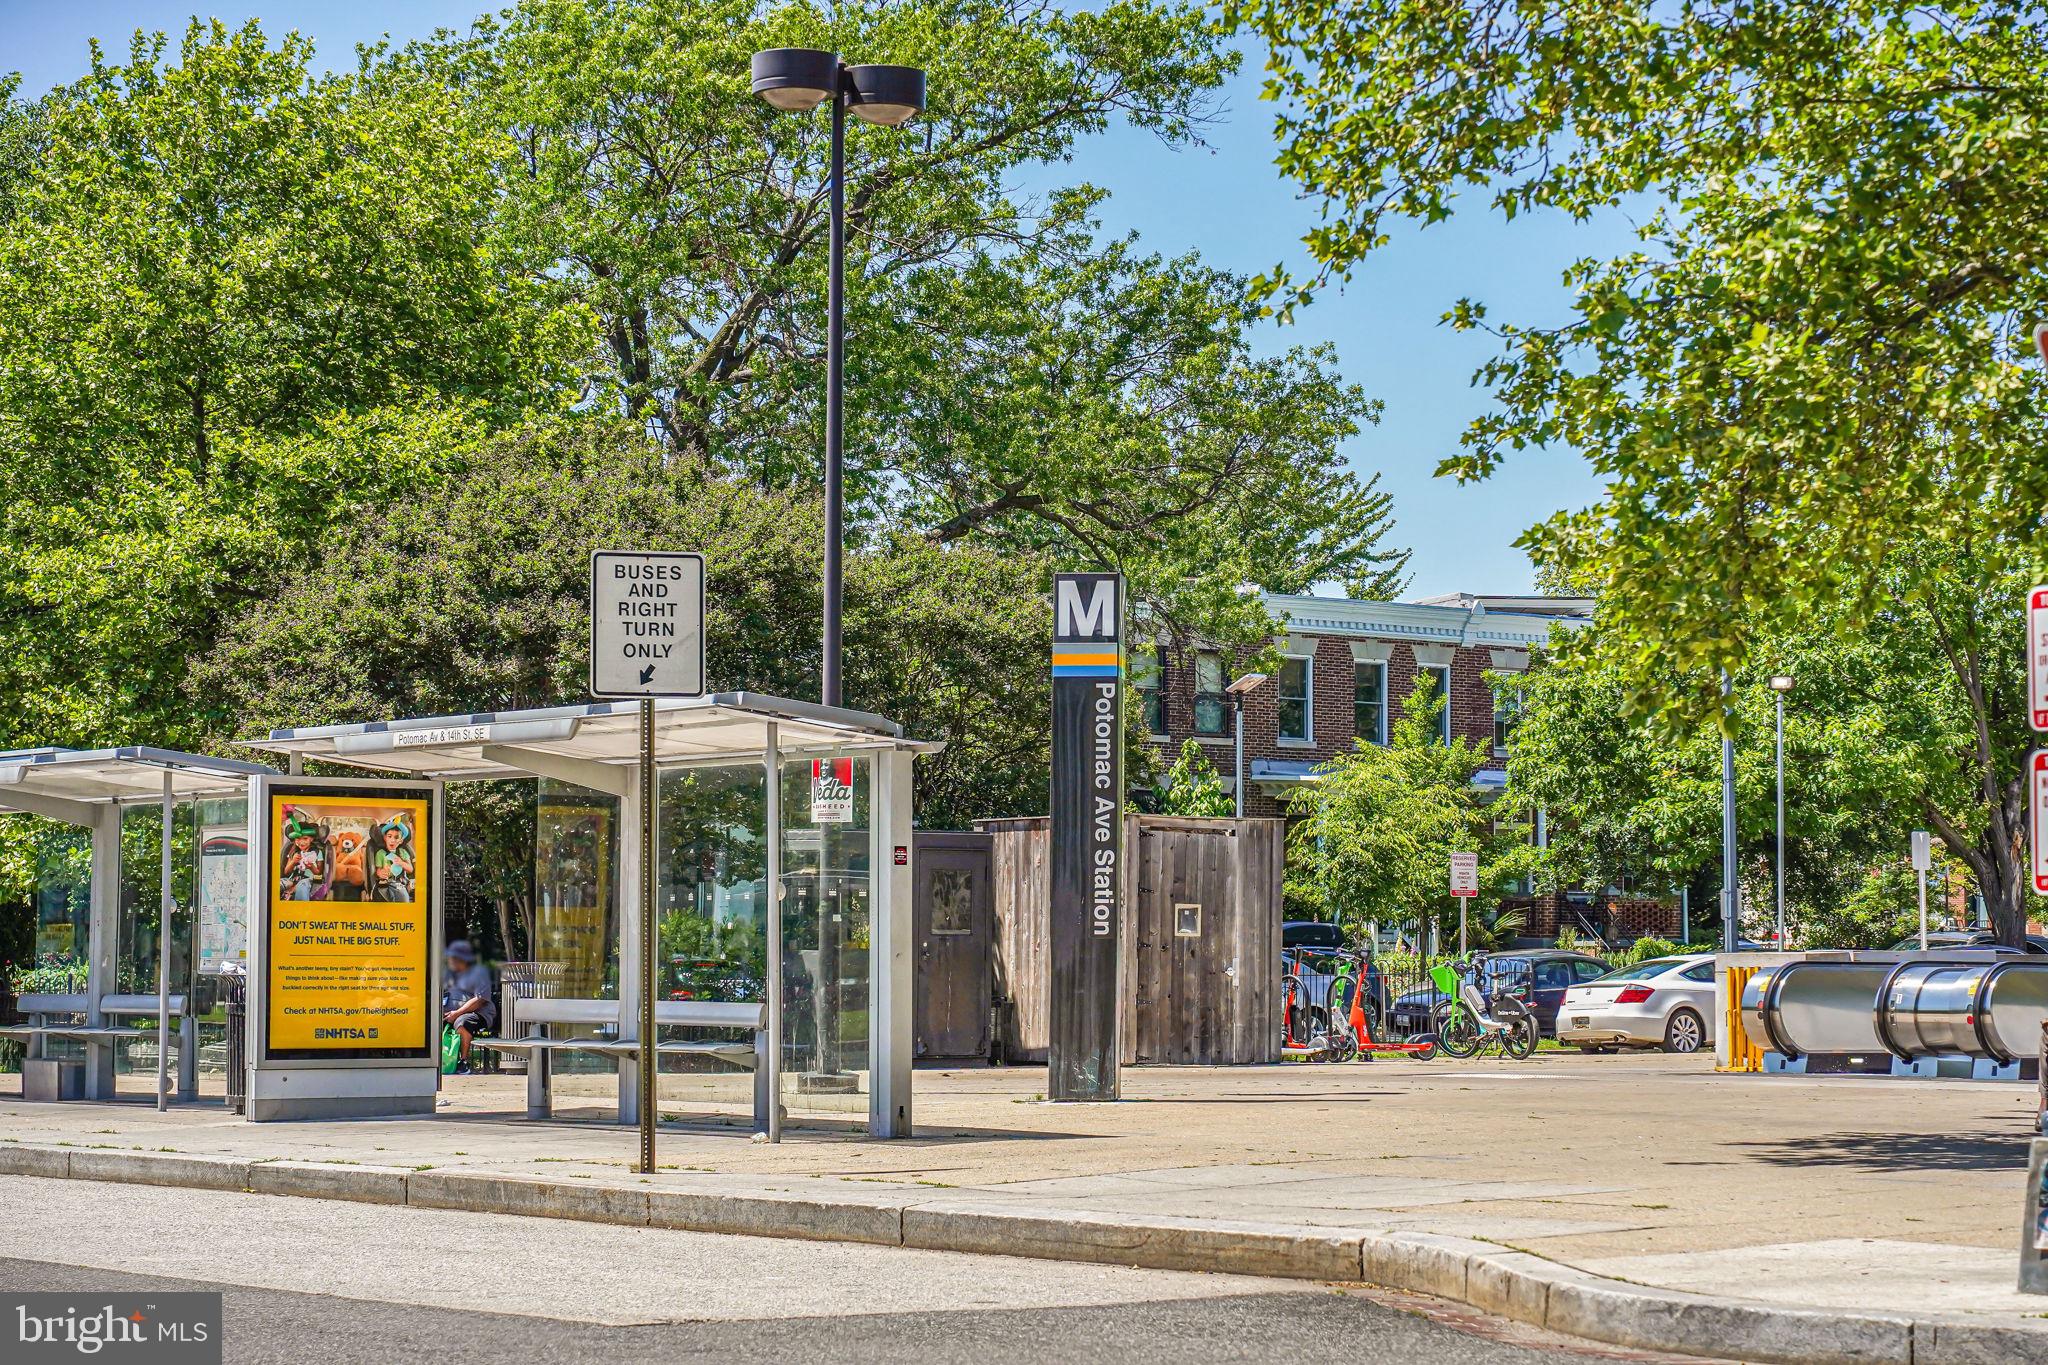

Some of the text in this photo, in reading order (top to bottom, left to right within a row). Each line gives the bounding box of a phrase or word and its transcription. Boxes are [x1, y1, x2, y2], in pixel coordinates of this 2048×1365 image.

[614, 564, 682, 580] BUSES
[628, 583, 668, 598] AND
[618, 602, 677, 617] RIGHT
[1057, 580, 1115, 637] M
[622, 621, 675, 637] TURN
[623, 643, 673, 658] ONLY
[398, 734, 428, 745] Potomac
[429, 732, 438, 742] Av
[440, 731, 445, 742] &
[447, 730, 461, 741] 14th
[474, 728, 484, 739] SE
[1094, 682, 1116, 936] Potomac Ave Station
[279, 921, 416, 932] DON'T SWEAT THE SMALL STUFF,
[293, 936, 400, 946] JUST NAIL THE BIG STUFF.
[318, 1007, 409, 1016] NHTSA.gov/TheRightSeat
[325, 1028, 366, 1039] NHTSA
